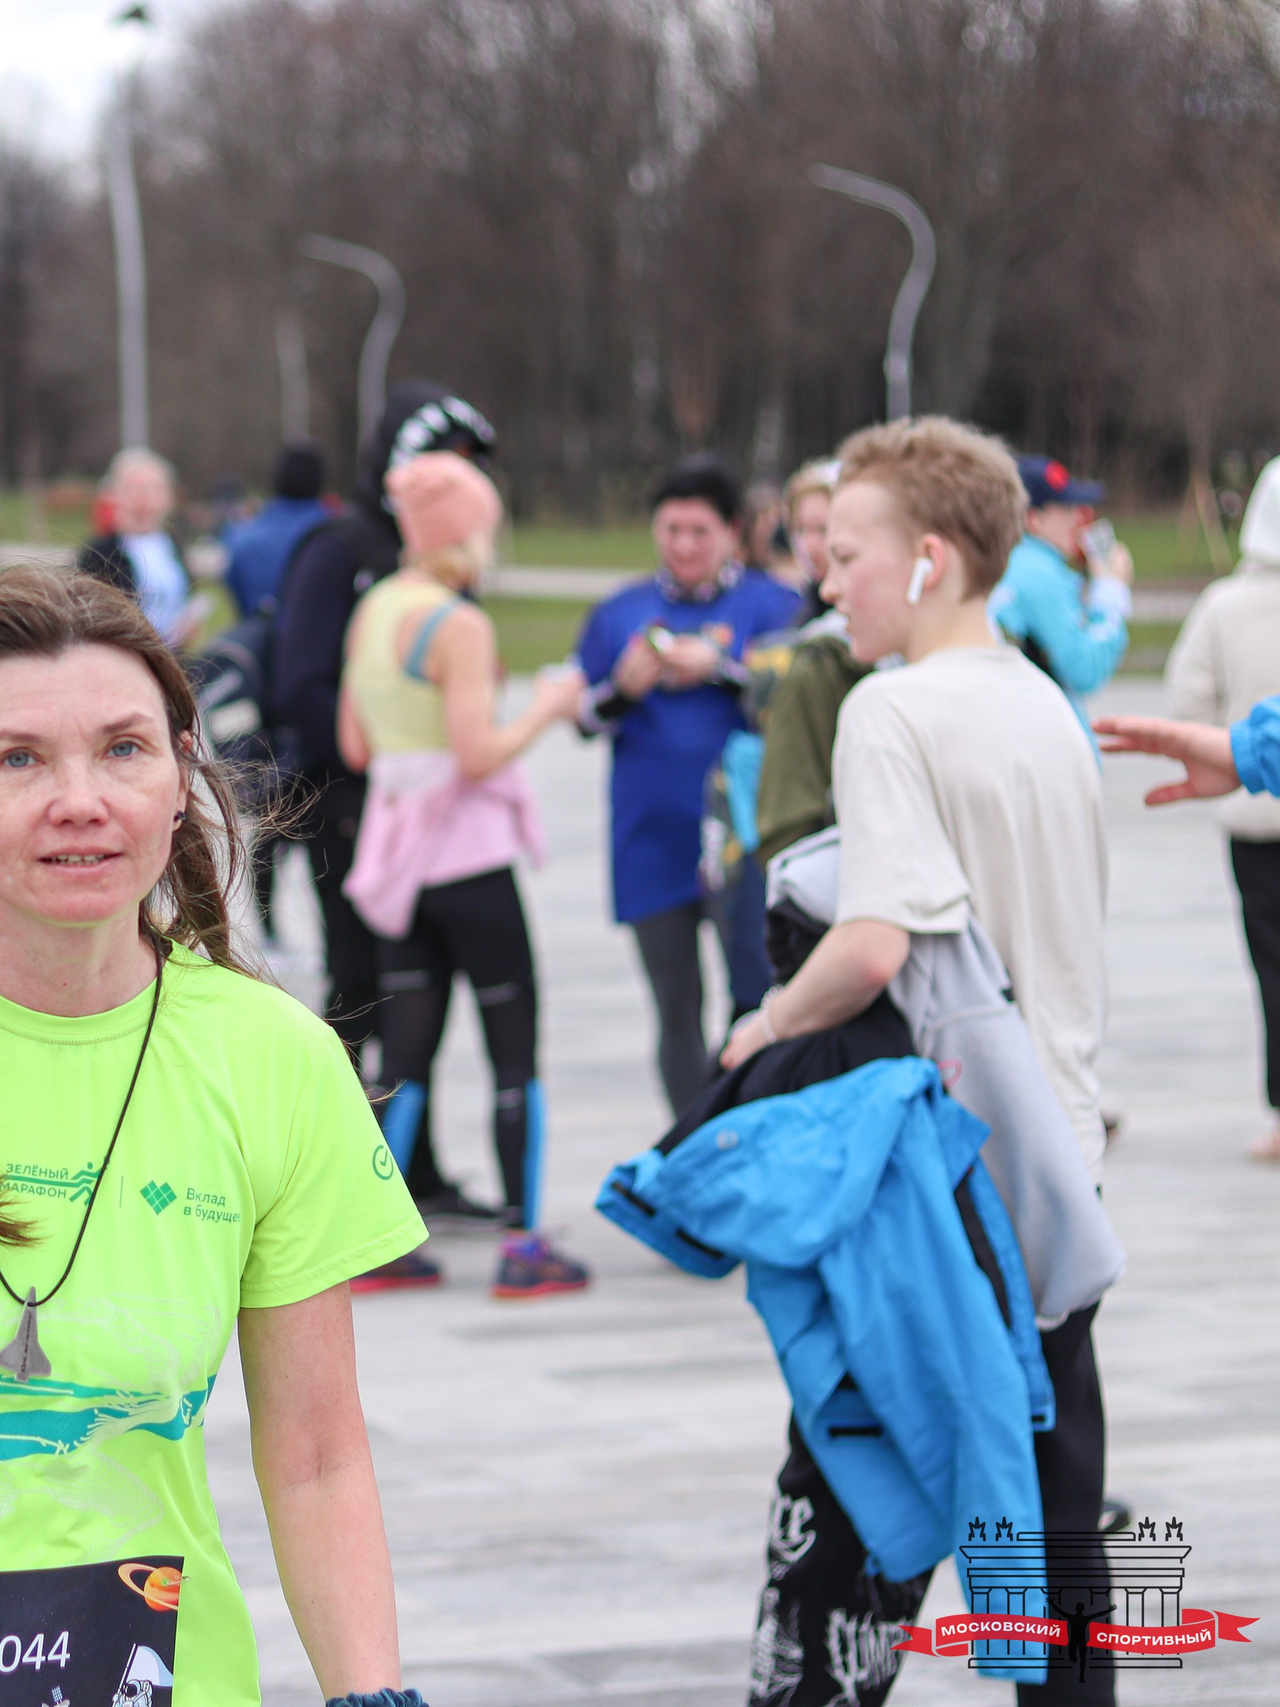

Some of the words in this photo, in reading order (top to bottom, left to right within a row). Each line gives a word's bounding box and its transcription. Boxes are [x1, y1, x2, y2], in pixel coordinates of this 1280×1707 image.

[6, 1163, 69, 1180] ЗЕЛЁНЫЙ
[0, 1181, 67, 1199] МАРАФОН
[186, 1187, 226, 1207] Вклад
[183, 1206, 192, 1216] в
[195, 1204, 241, 1224] будуще
